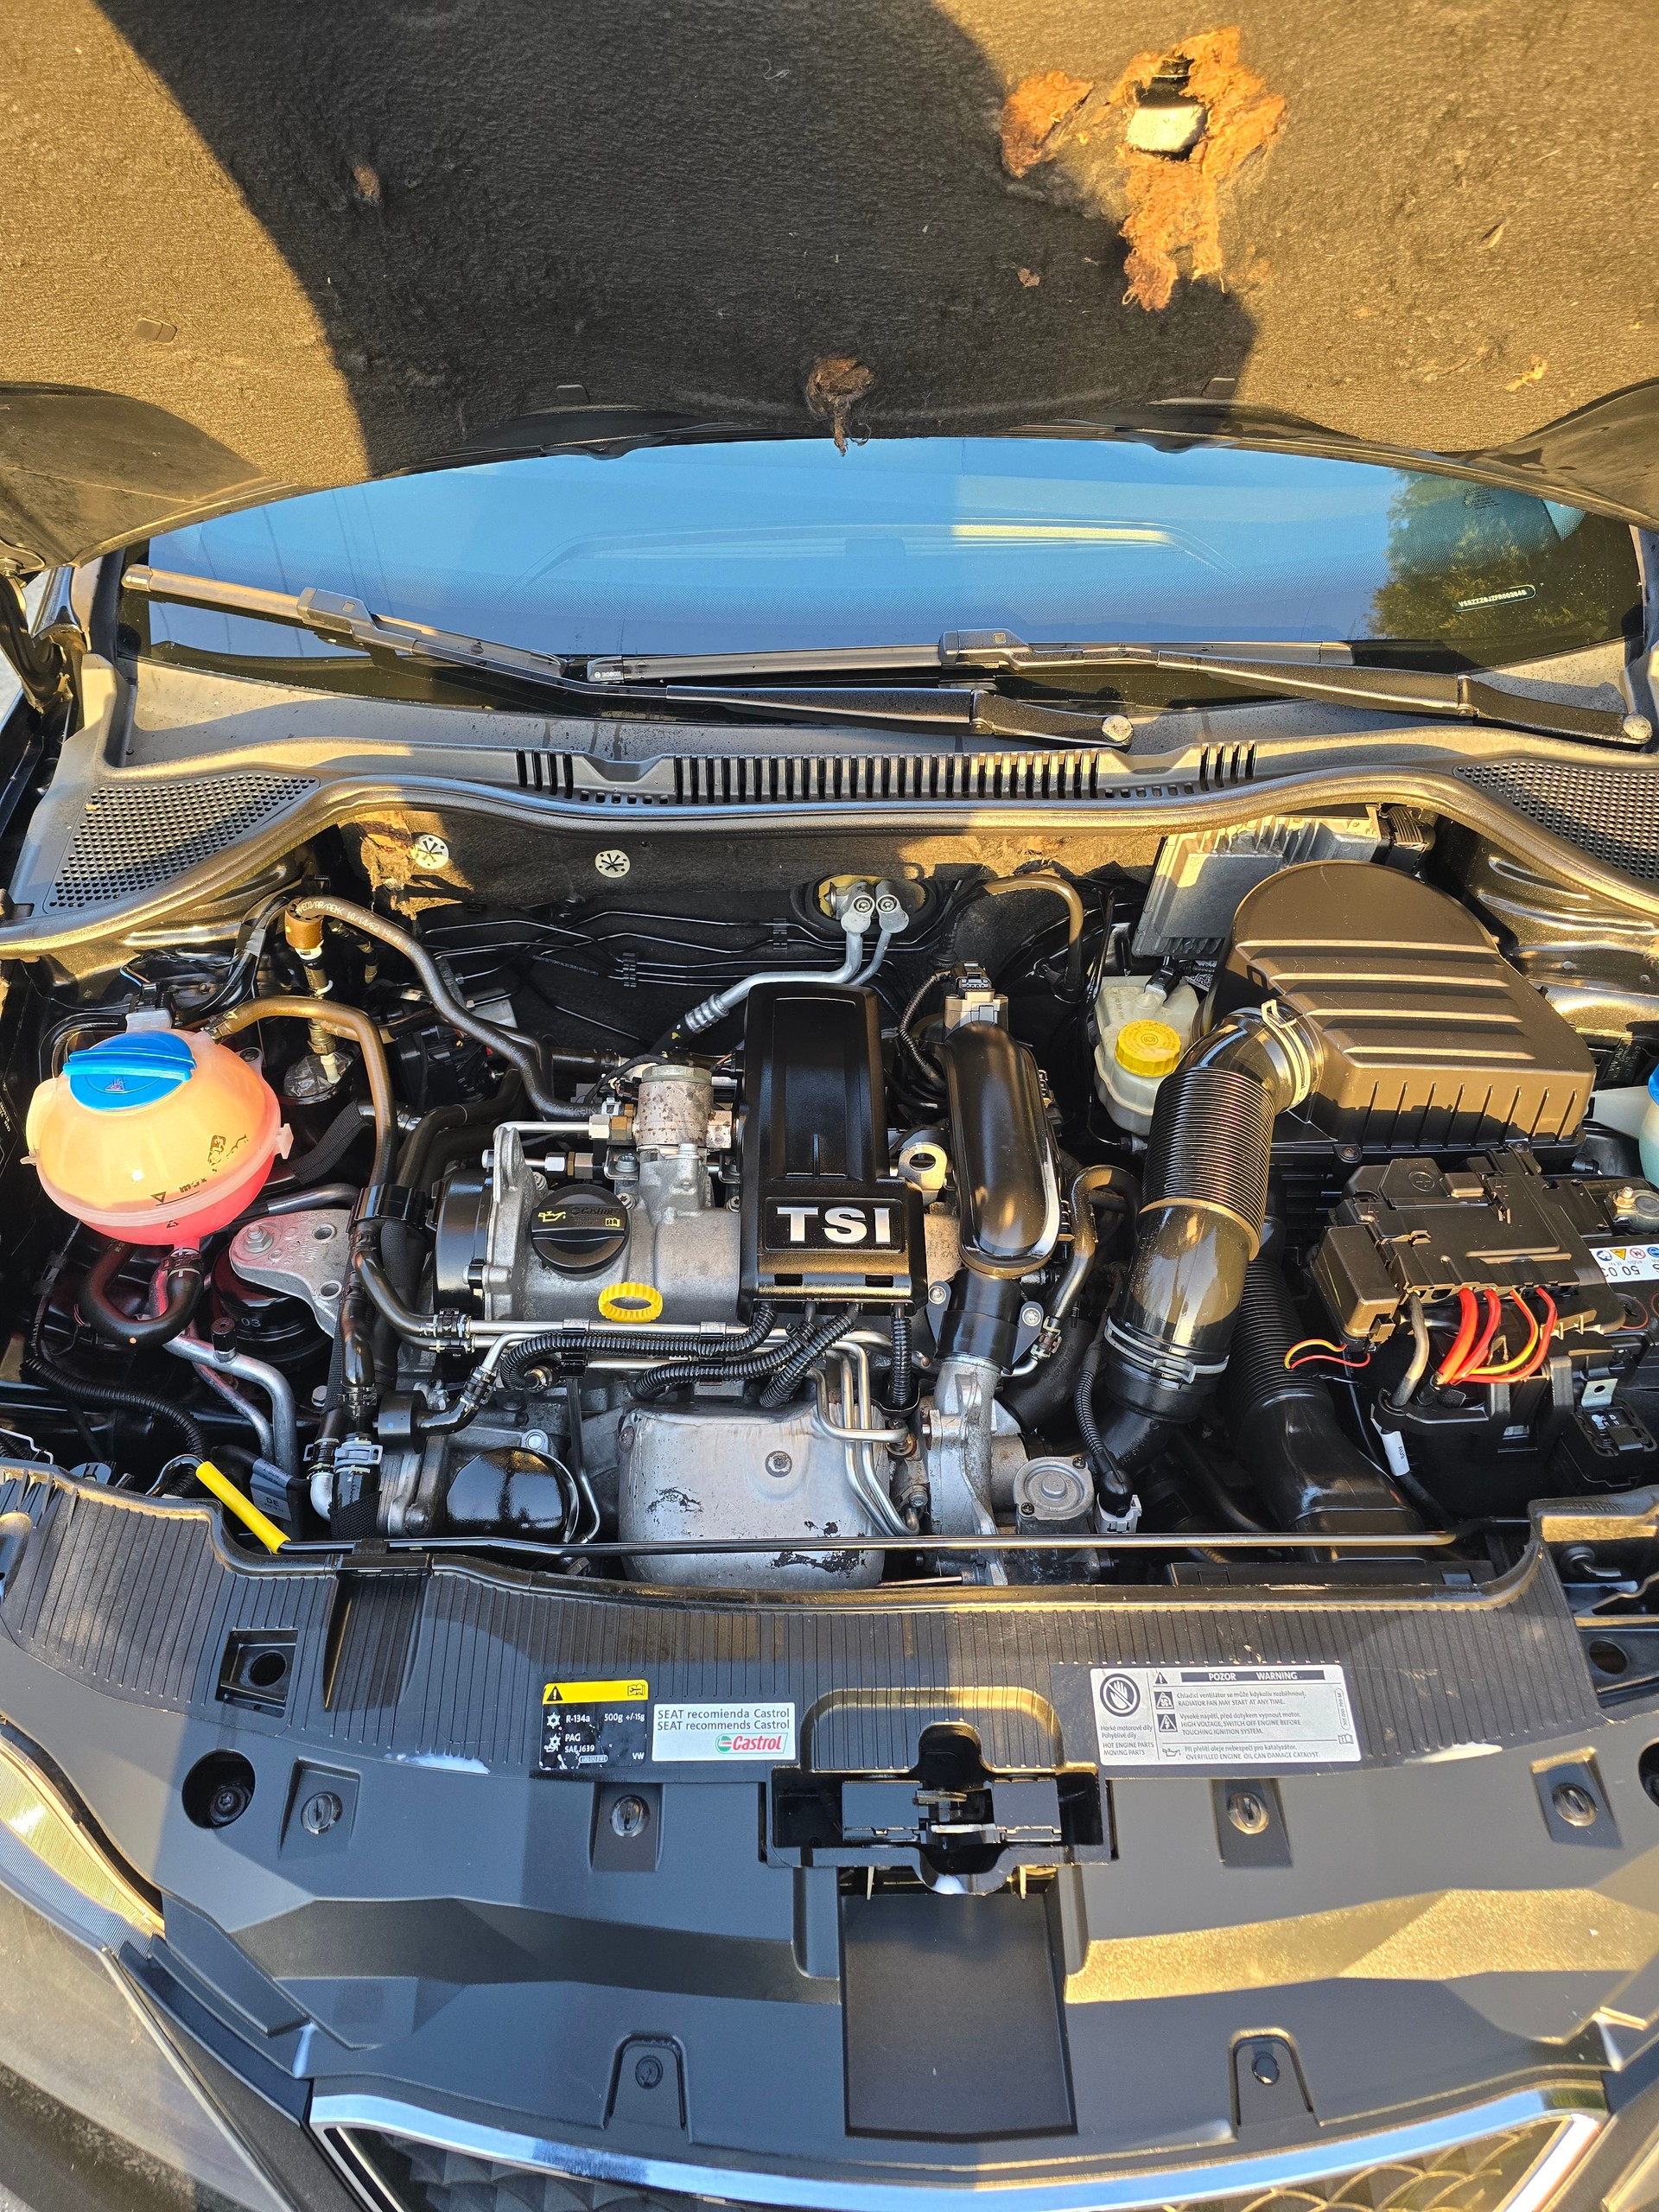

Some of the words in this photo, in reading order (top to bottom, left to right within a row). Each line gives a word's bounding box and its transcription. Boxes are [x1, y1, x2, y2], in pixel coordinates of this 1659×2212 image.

[776, 1205, 892, 1244] TSI
[241, 1317, 261, 1327] 03
[1208, 1672, 1237, 1681] POZOR
[1255, 1671, 1299, 1681] WARNING
[565, 1713, 591, 1723] R-134a
[603, 1713, 624, 1723] 500g
[657, 1709, 684, 1719] SEAT
[687, 1707, 750, 1719] recomienda
[753, 1707, 790, 1719] Castrol
[1233, 1712, 1258, 1720] dotykem
[657, 1720, 683, 1731] SEAT
[685, 1719, 751, 1731] recommends
[753, 1719, 790, 1730] Castrol
[564, 1732, 582, 1742] PAG
[733, 1735, 782, 1751] Castrol
[632, 1751, 645, 1760] VW
